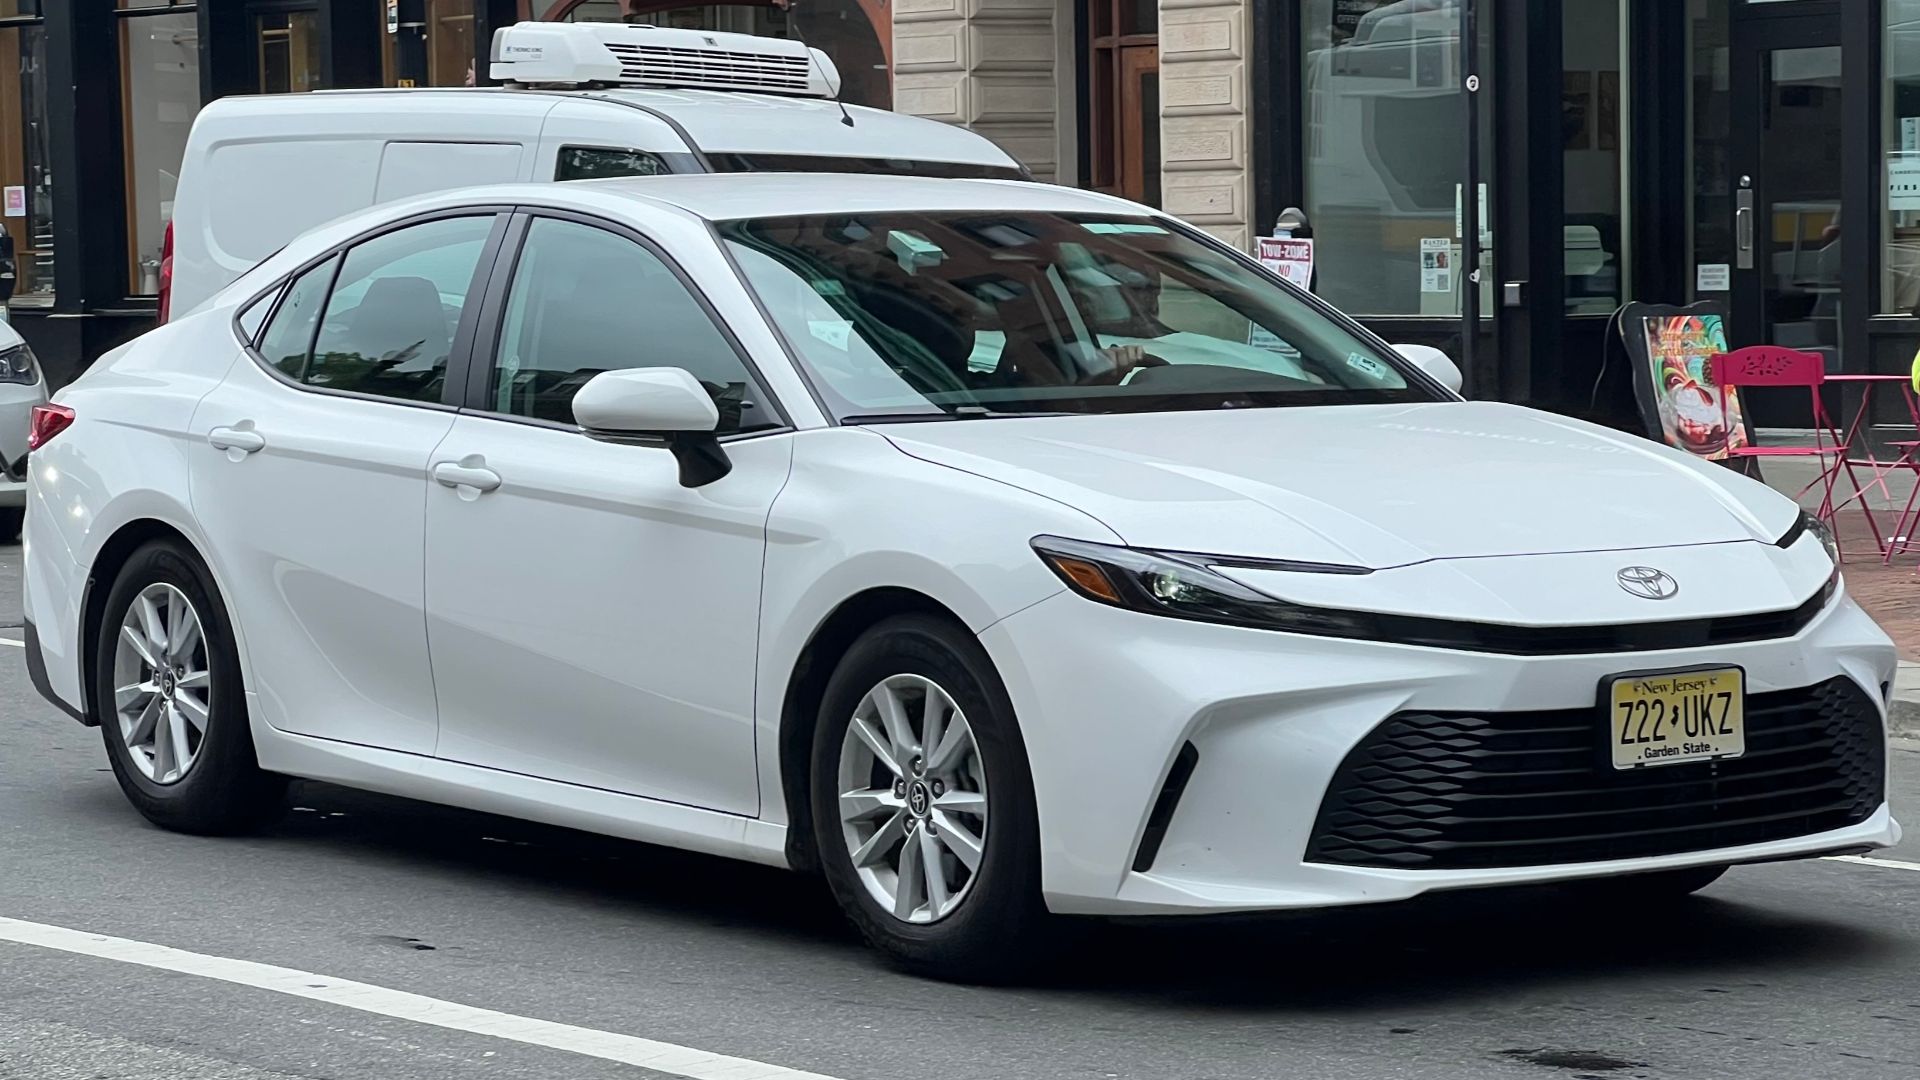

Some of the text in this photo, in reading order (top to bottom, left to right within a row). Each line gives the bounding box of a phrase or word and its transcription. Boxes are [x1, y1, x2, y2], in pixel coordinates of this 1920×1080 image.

[1261, 243, 1309, 259] TOW-ZONE
[1279, 264, 1290, 277] NO
[1641, 679, 1707, 695] New Jersey
[1619, 691, 1733, 744] Z22 UKZ
[1644, 742, 1711, 758] Garden State
